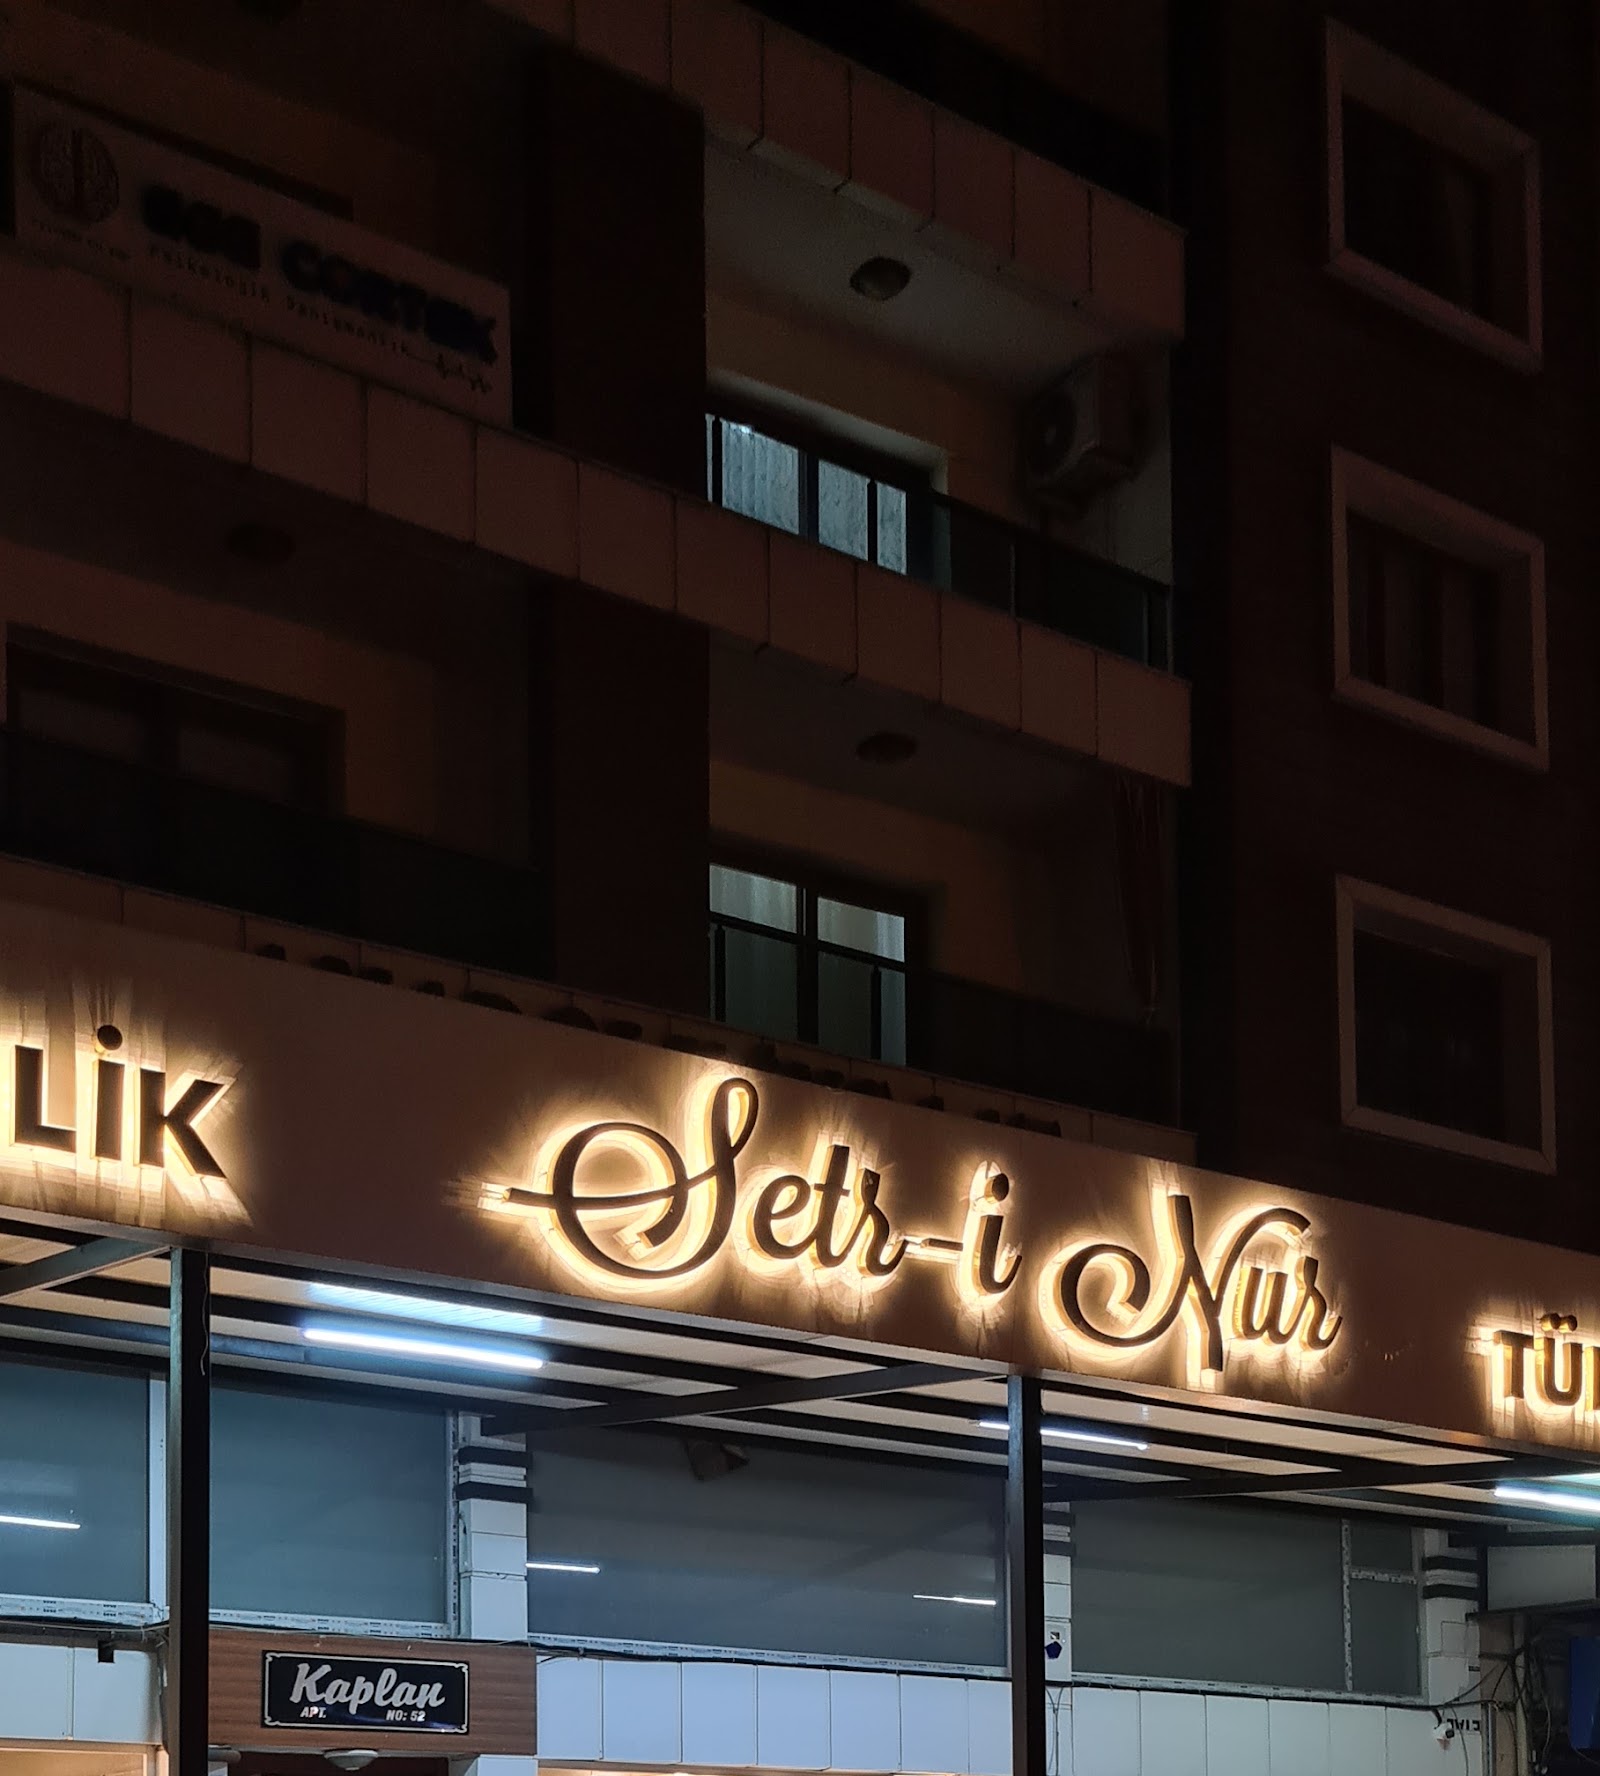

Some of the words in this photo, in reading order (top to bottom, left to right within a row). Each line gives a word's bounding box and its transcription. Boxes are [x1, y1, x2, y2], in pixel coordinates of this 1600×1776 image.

[1056, 1193, 1343, 1374] Nur
[1493, 1311, 1600, 1411] TÜ
[289, 1662, 446, 1715] Kaplan
[300, 1706, 327, 1719] APT.
[386, 1709, 408, 1721] NO:
[410, 1710, 426, 1722] 52
